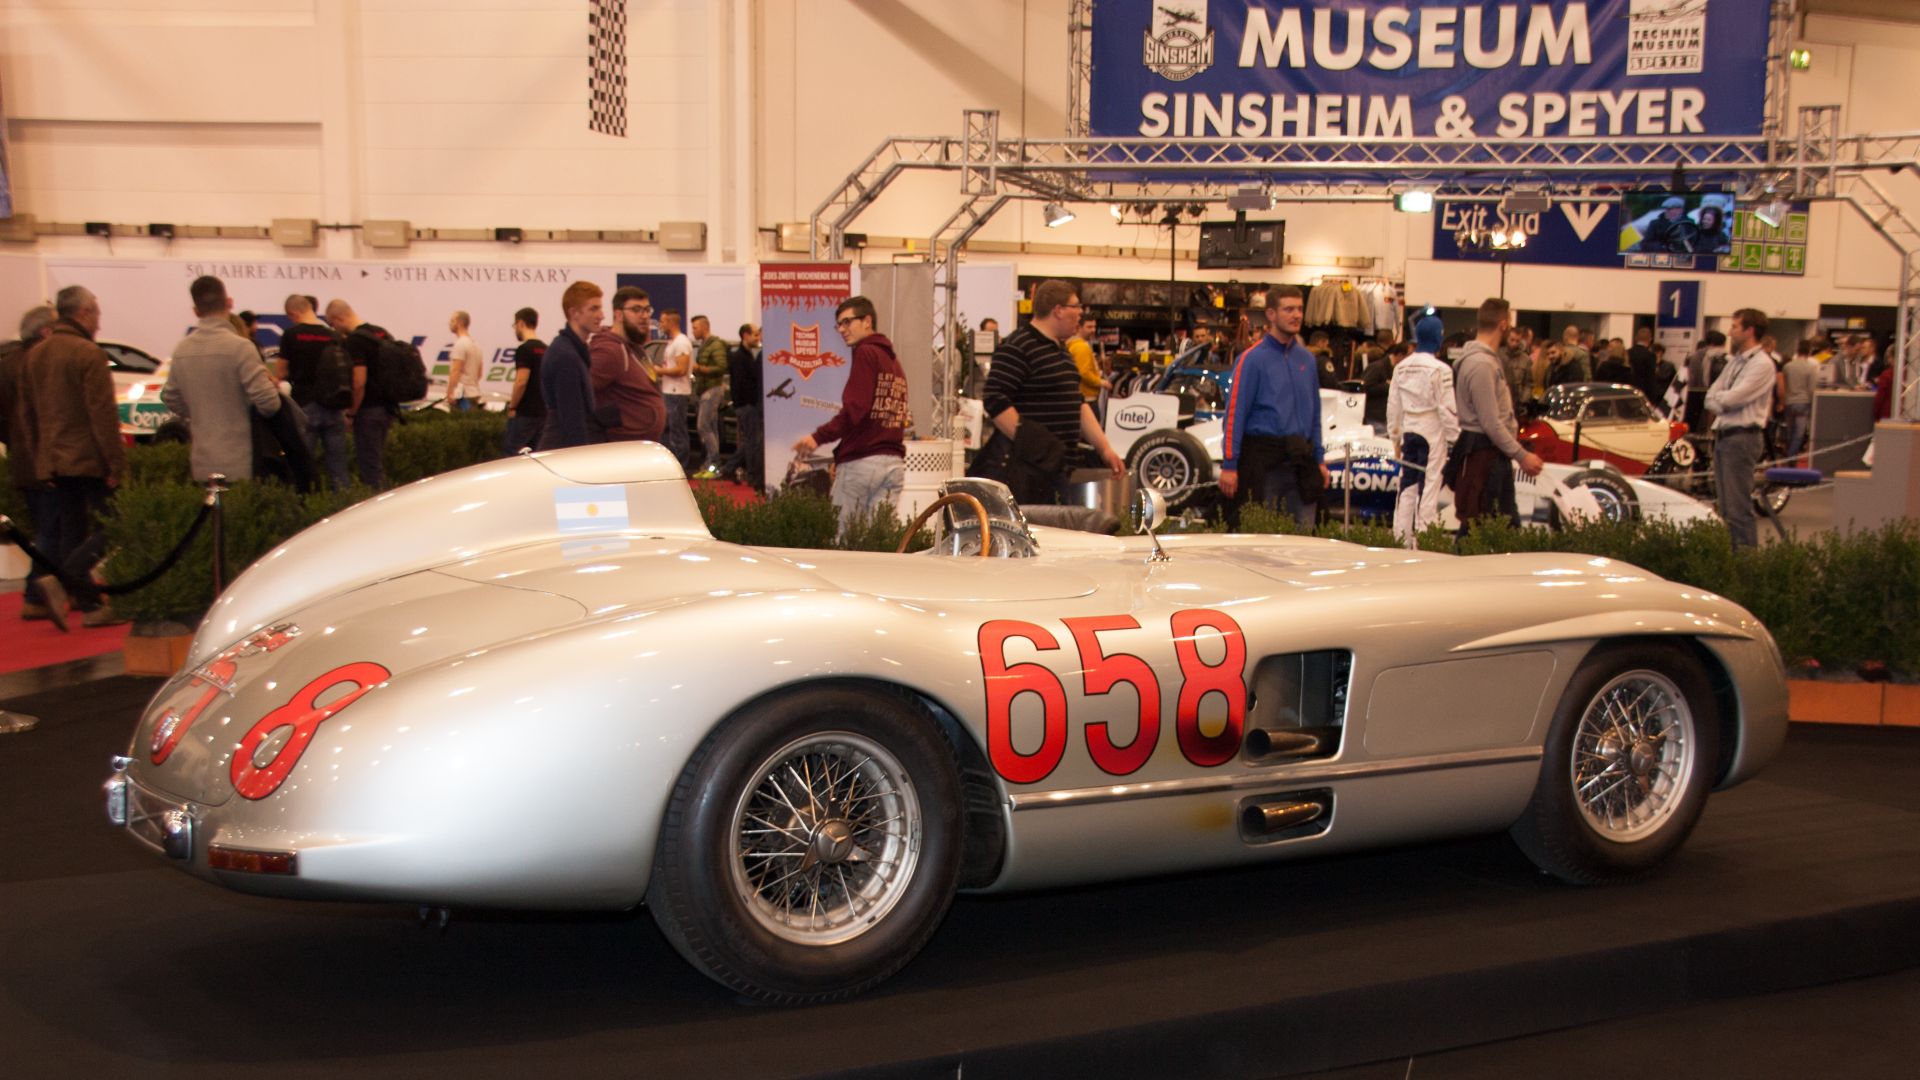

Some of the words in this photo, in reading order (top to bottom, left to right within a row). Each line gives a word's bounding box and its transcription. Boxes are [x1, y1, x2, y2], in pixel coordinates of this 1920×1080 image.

[1238, 3, 1592, 70] MUSEUM
[1631, 39, 1700, 51] MUSEUM
[1632, 28, 1700, 40] TECHNIK
[1145, 37, 1212, 64] SINSHEIM
[1138, 91, 1414, 138] SINSHEIM
[1434, 94, 1477, 138] &
[1495, 87, 1706, 138] SPEYER
[1441, 202, 1488, 231] Exit
[186, 264, 205, 278] 50
[212, 264, 269, 279] JAHRE
[274, 265, 343, 280] ALPINA
[384, 266, 428, 281] 50TH
[433, 268, 571, 283] ANNIVERSARY
[1669, 288, 1681, 319] 1
[1119, 409, 1149, 424] intel
[1675, 444, 1691, 460] 12
[977, 608, 1247, 785] 658
